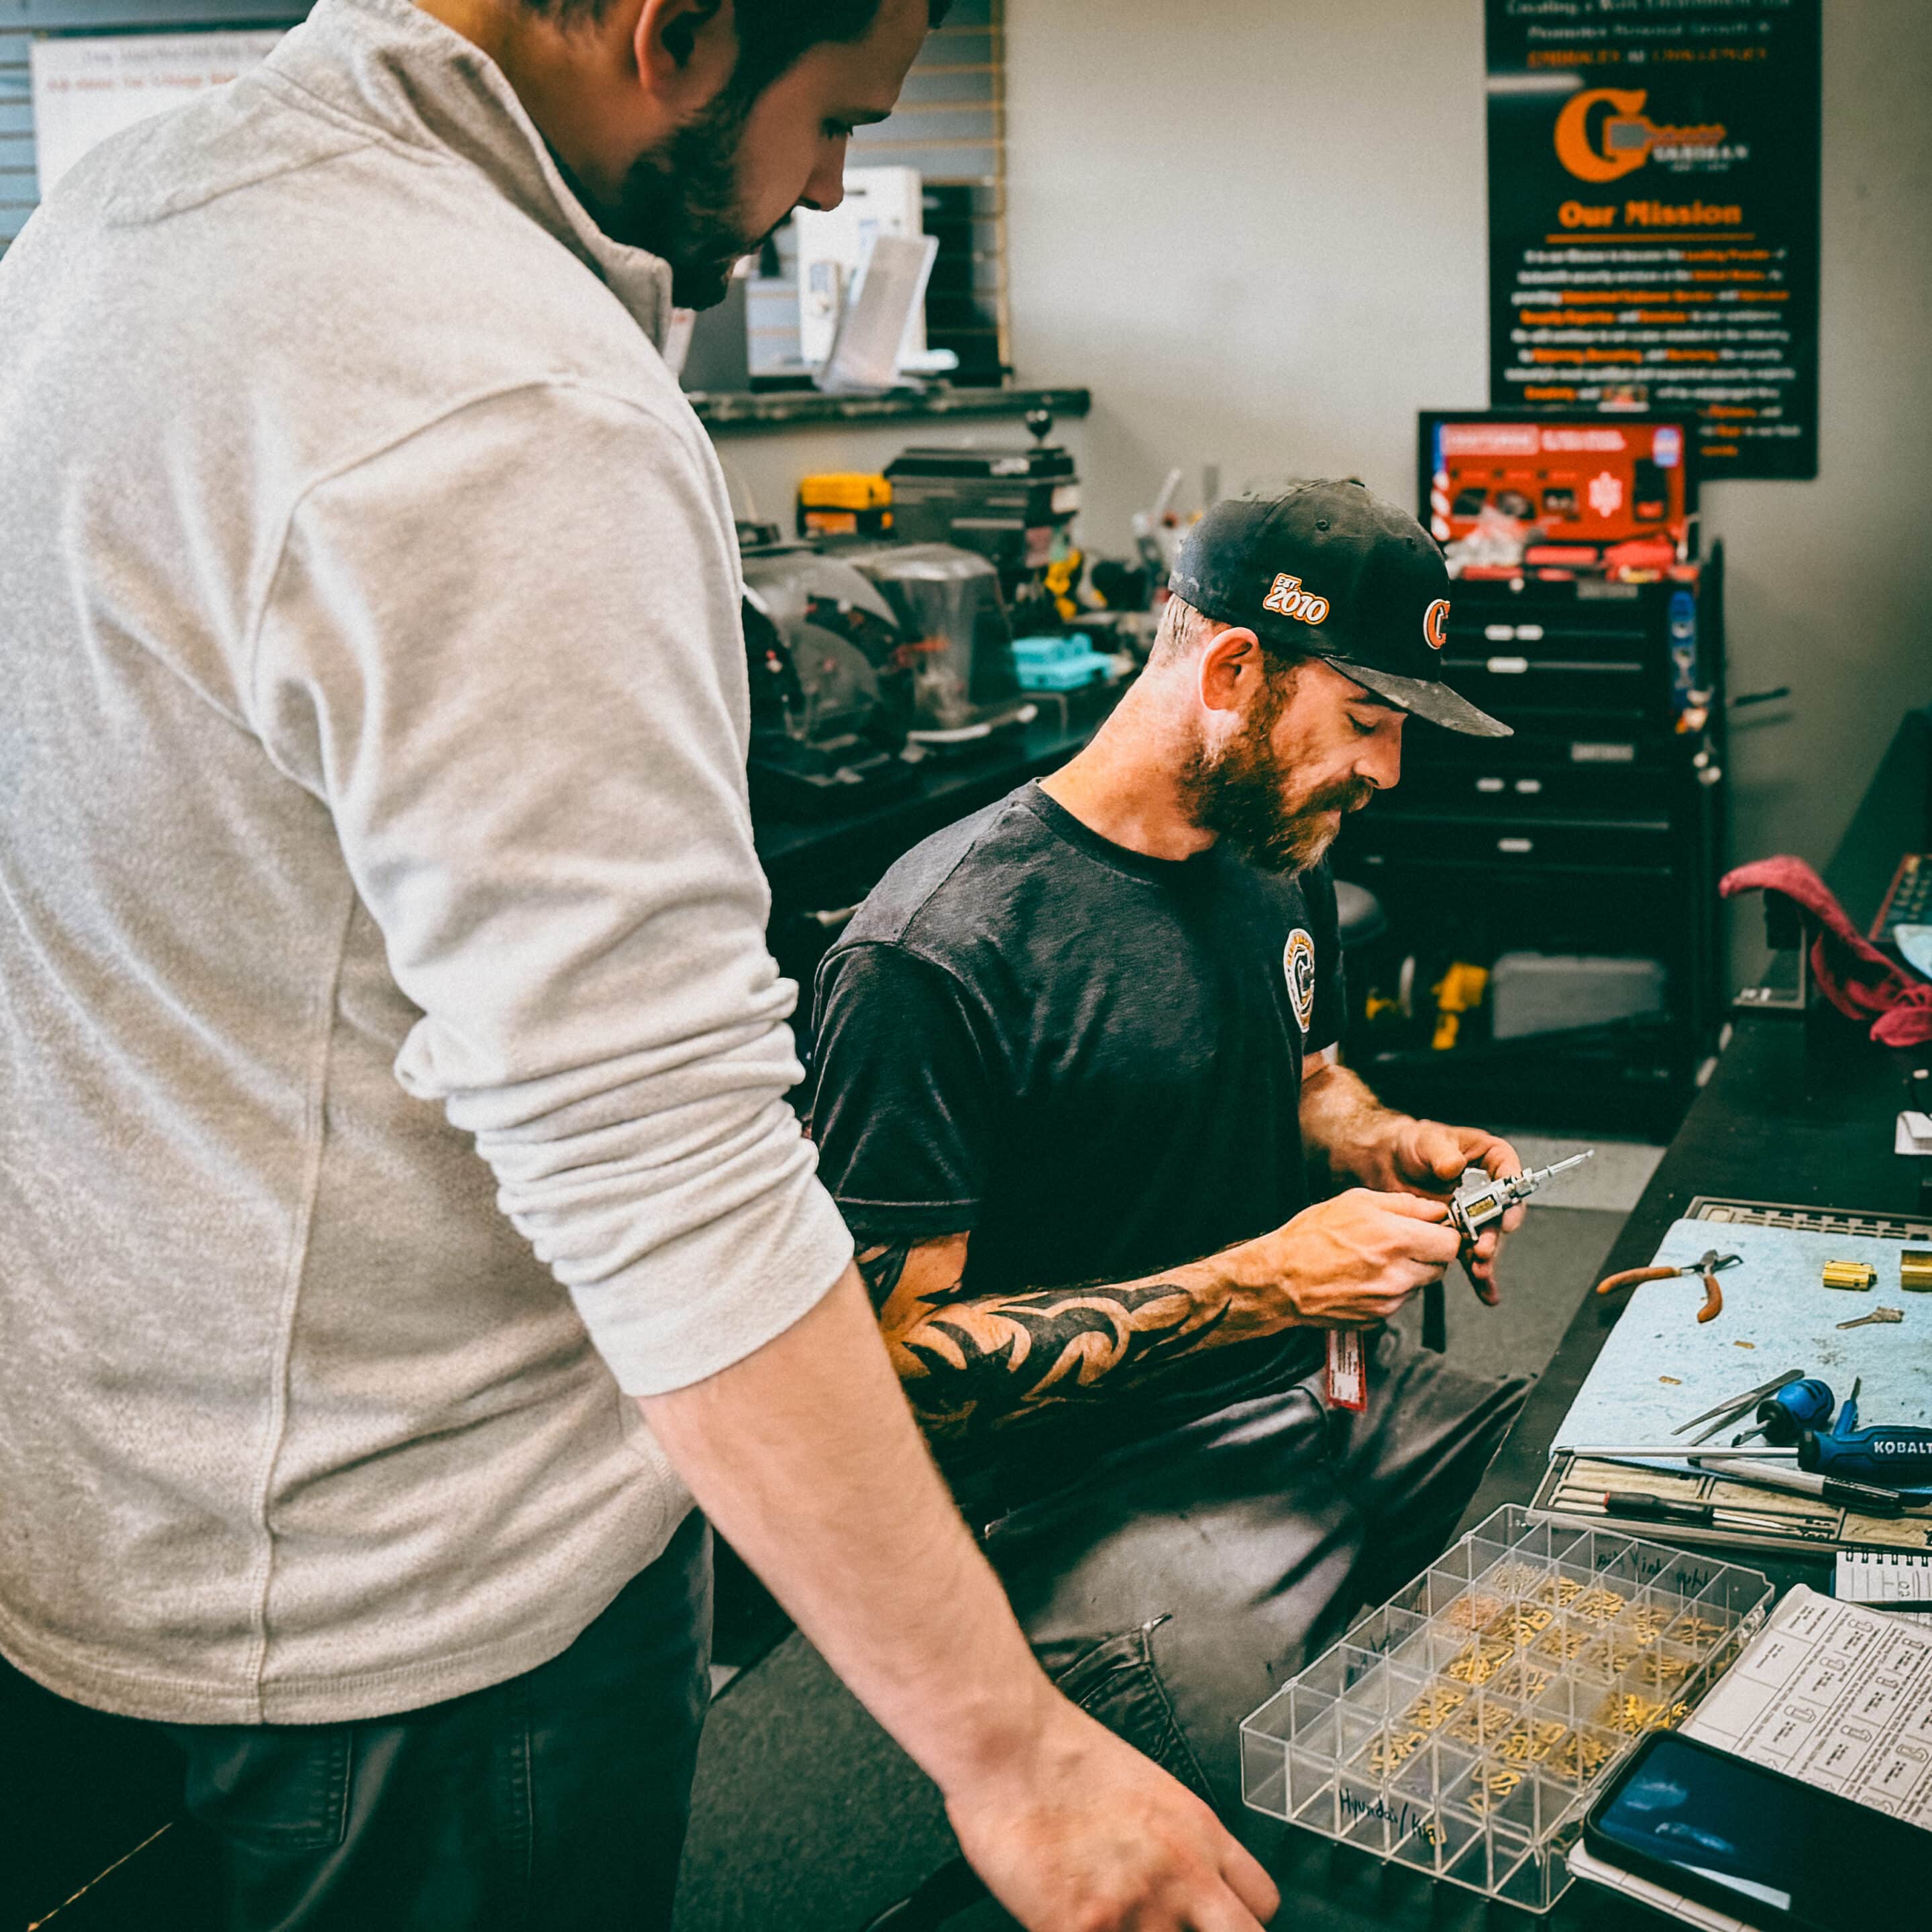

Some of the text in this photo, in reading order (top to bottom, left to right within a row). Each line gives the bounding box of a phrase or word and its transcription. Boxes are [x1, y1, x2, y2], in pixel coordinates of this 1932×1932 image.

[1558, 200, 1742, 228] Our Mission
[1265, 586, 1326, 622] 2010
[1874, 1441, 1932, 1454] KOBALT
